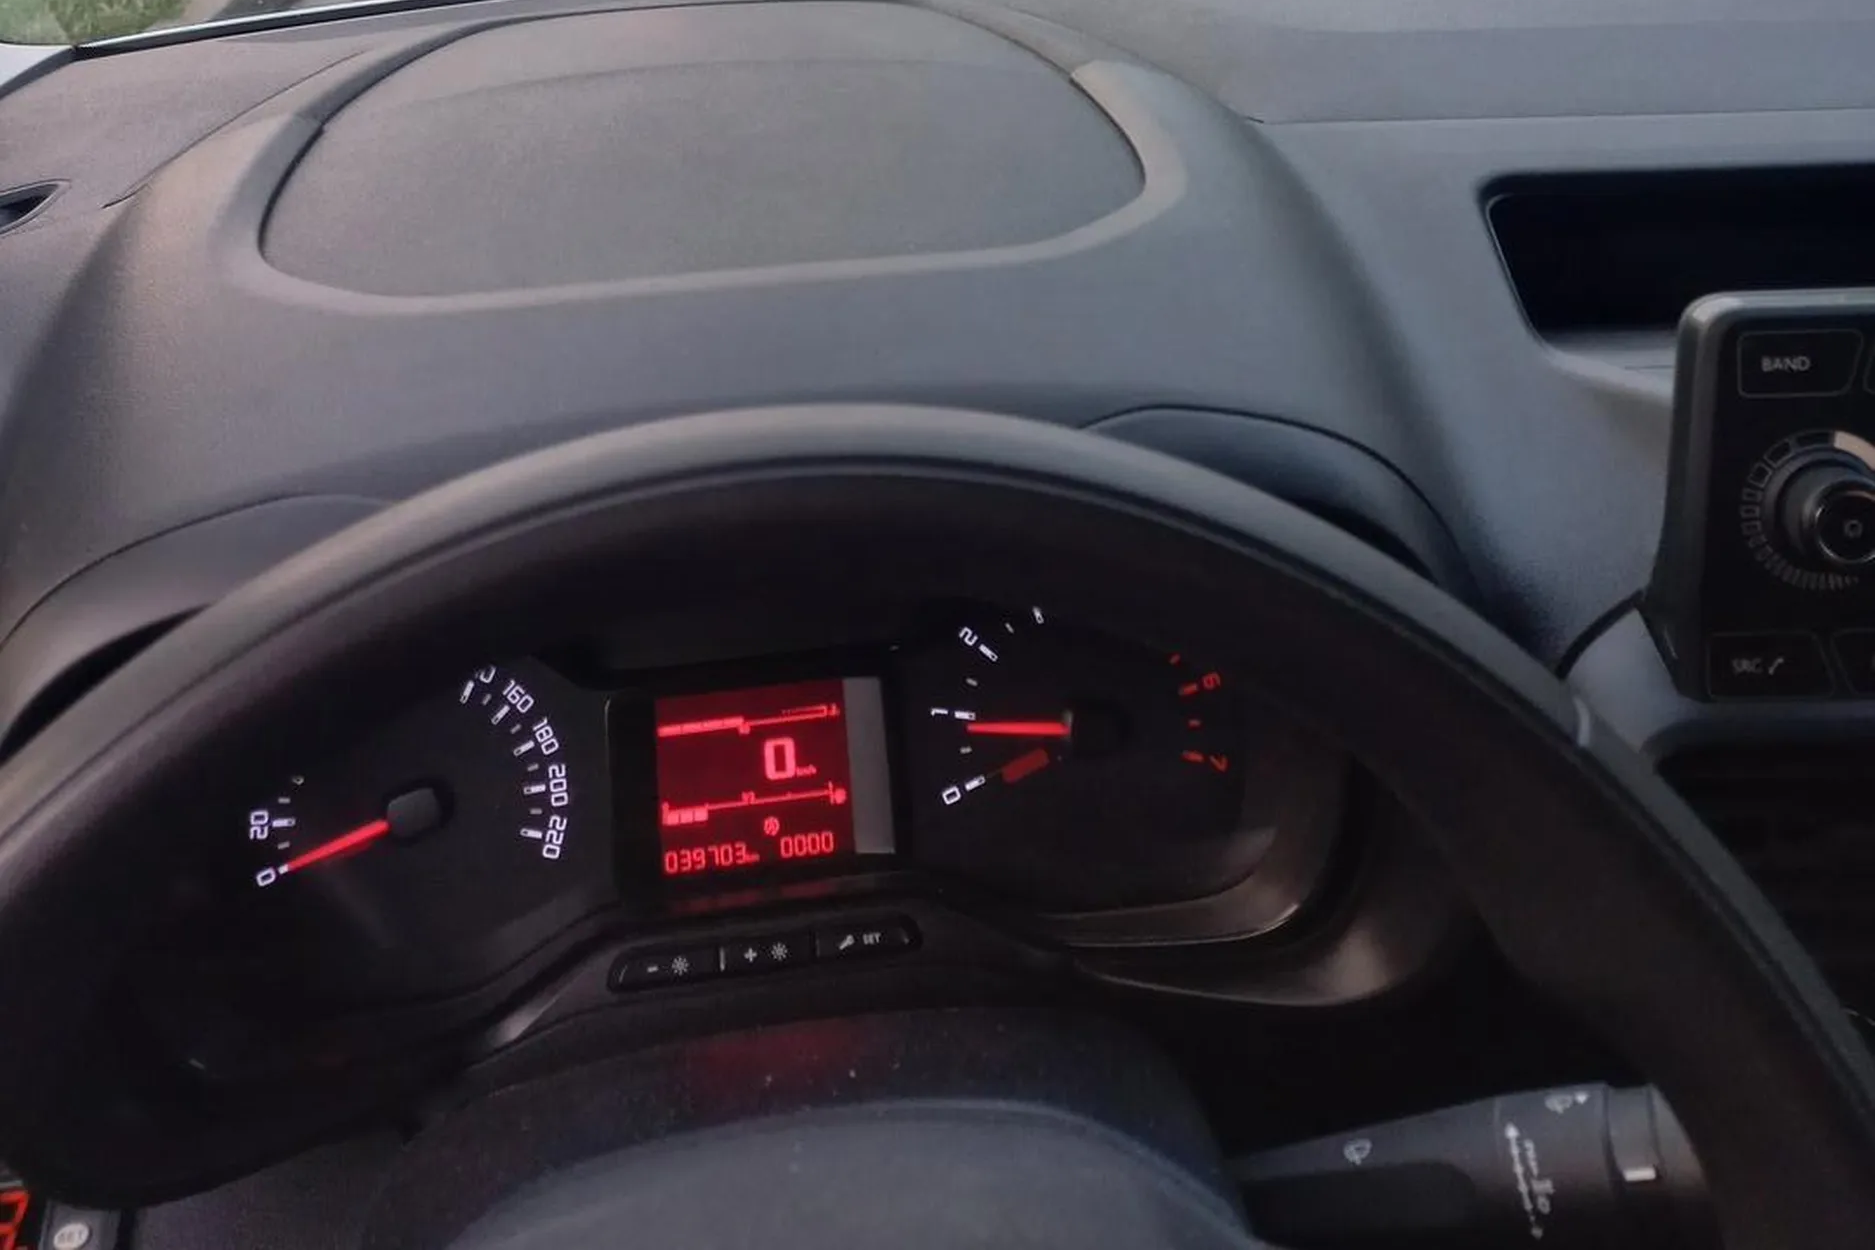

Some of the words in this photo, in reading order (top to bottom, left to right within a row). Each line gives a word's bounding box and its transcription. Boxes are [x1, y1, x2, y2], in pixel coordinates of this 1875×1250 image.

[1761, 356, 1811, 373] BAND
[959, 627, 978, 646] 2
[502, 680, 534, 714] 160
[532, 718, 559, 756] 180
[764, 736, 797, 781] 0
[548, 763, 569, 808] 200
[942, 786, 961, 805] 0
[250, 810, 269, 840] 20
[542, 815, 568, 860] 220
[256, 868, 276, 887] 0
